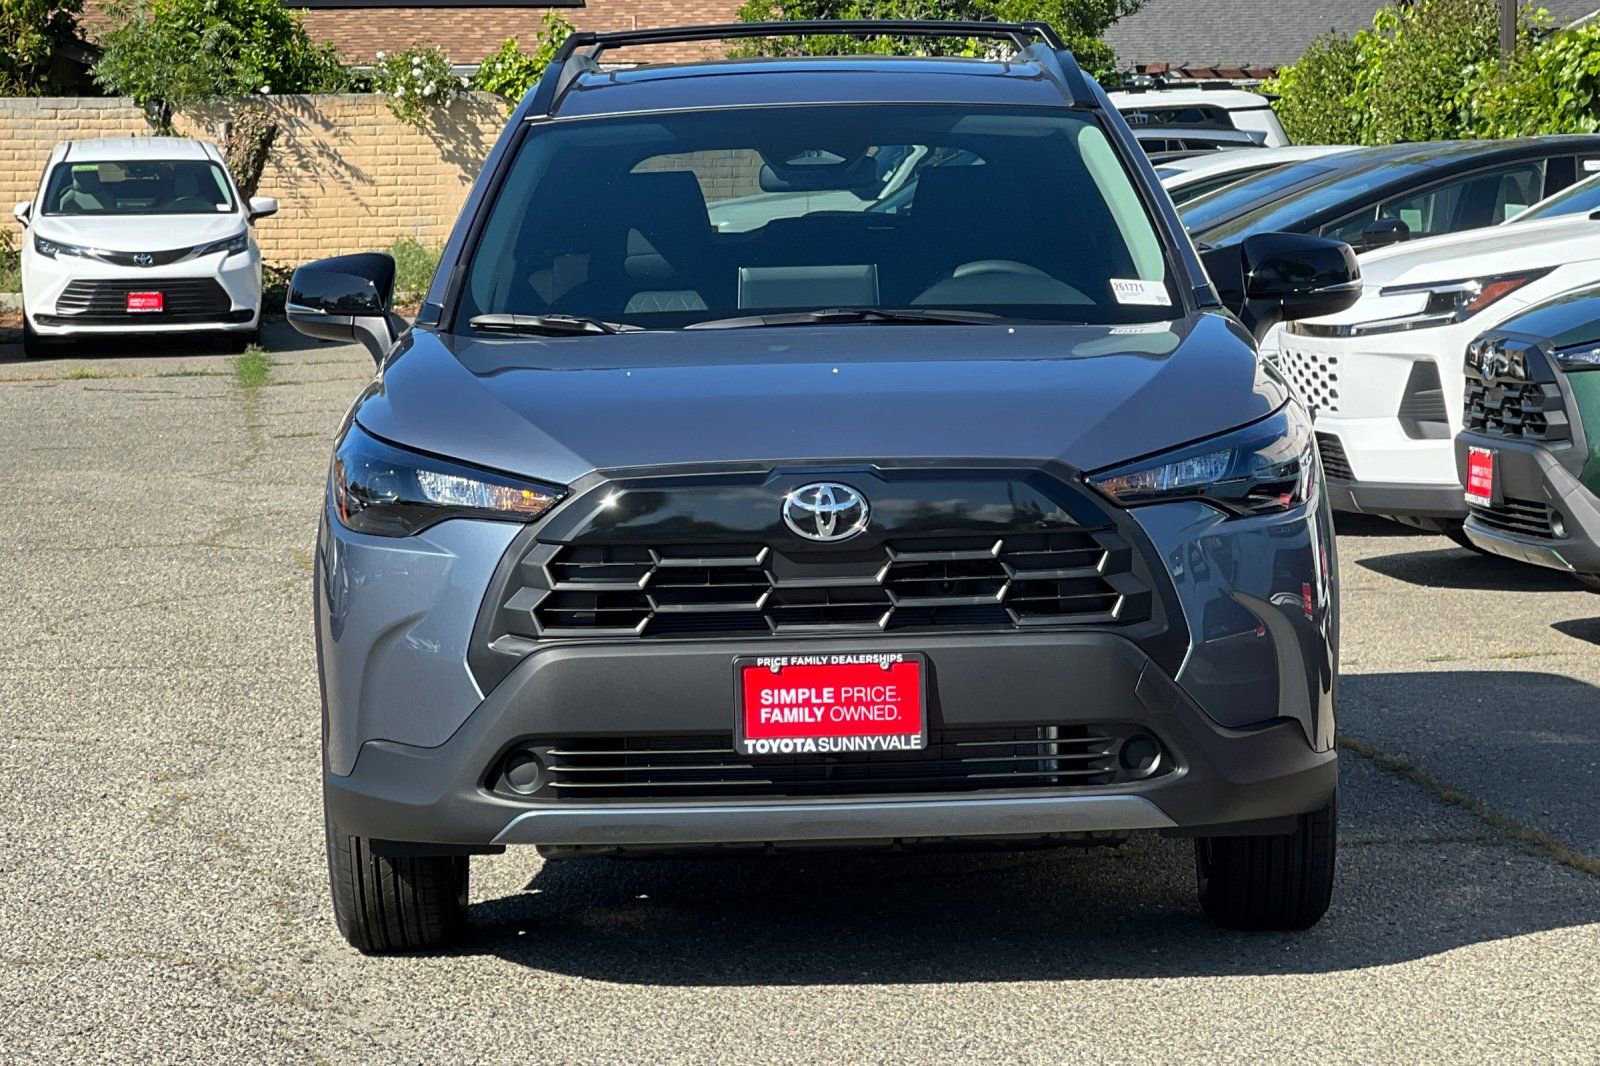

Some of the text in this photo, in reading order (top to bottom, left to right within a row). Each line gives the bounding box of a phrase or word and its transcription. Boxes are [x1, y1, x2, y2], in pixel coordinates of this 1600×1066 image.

[1114, 282, 1144, 292] 261771
[757, 654, 903, 667] PRICE FAMILY DEALERSHIPS
[760, 686, 901, 705] SIMPLE PRICE.
[760, 704, 902, 724] FAMILY OWNED.
